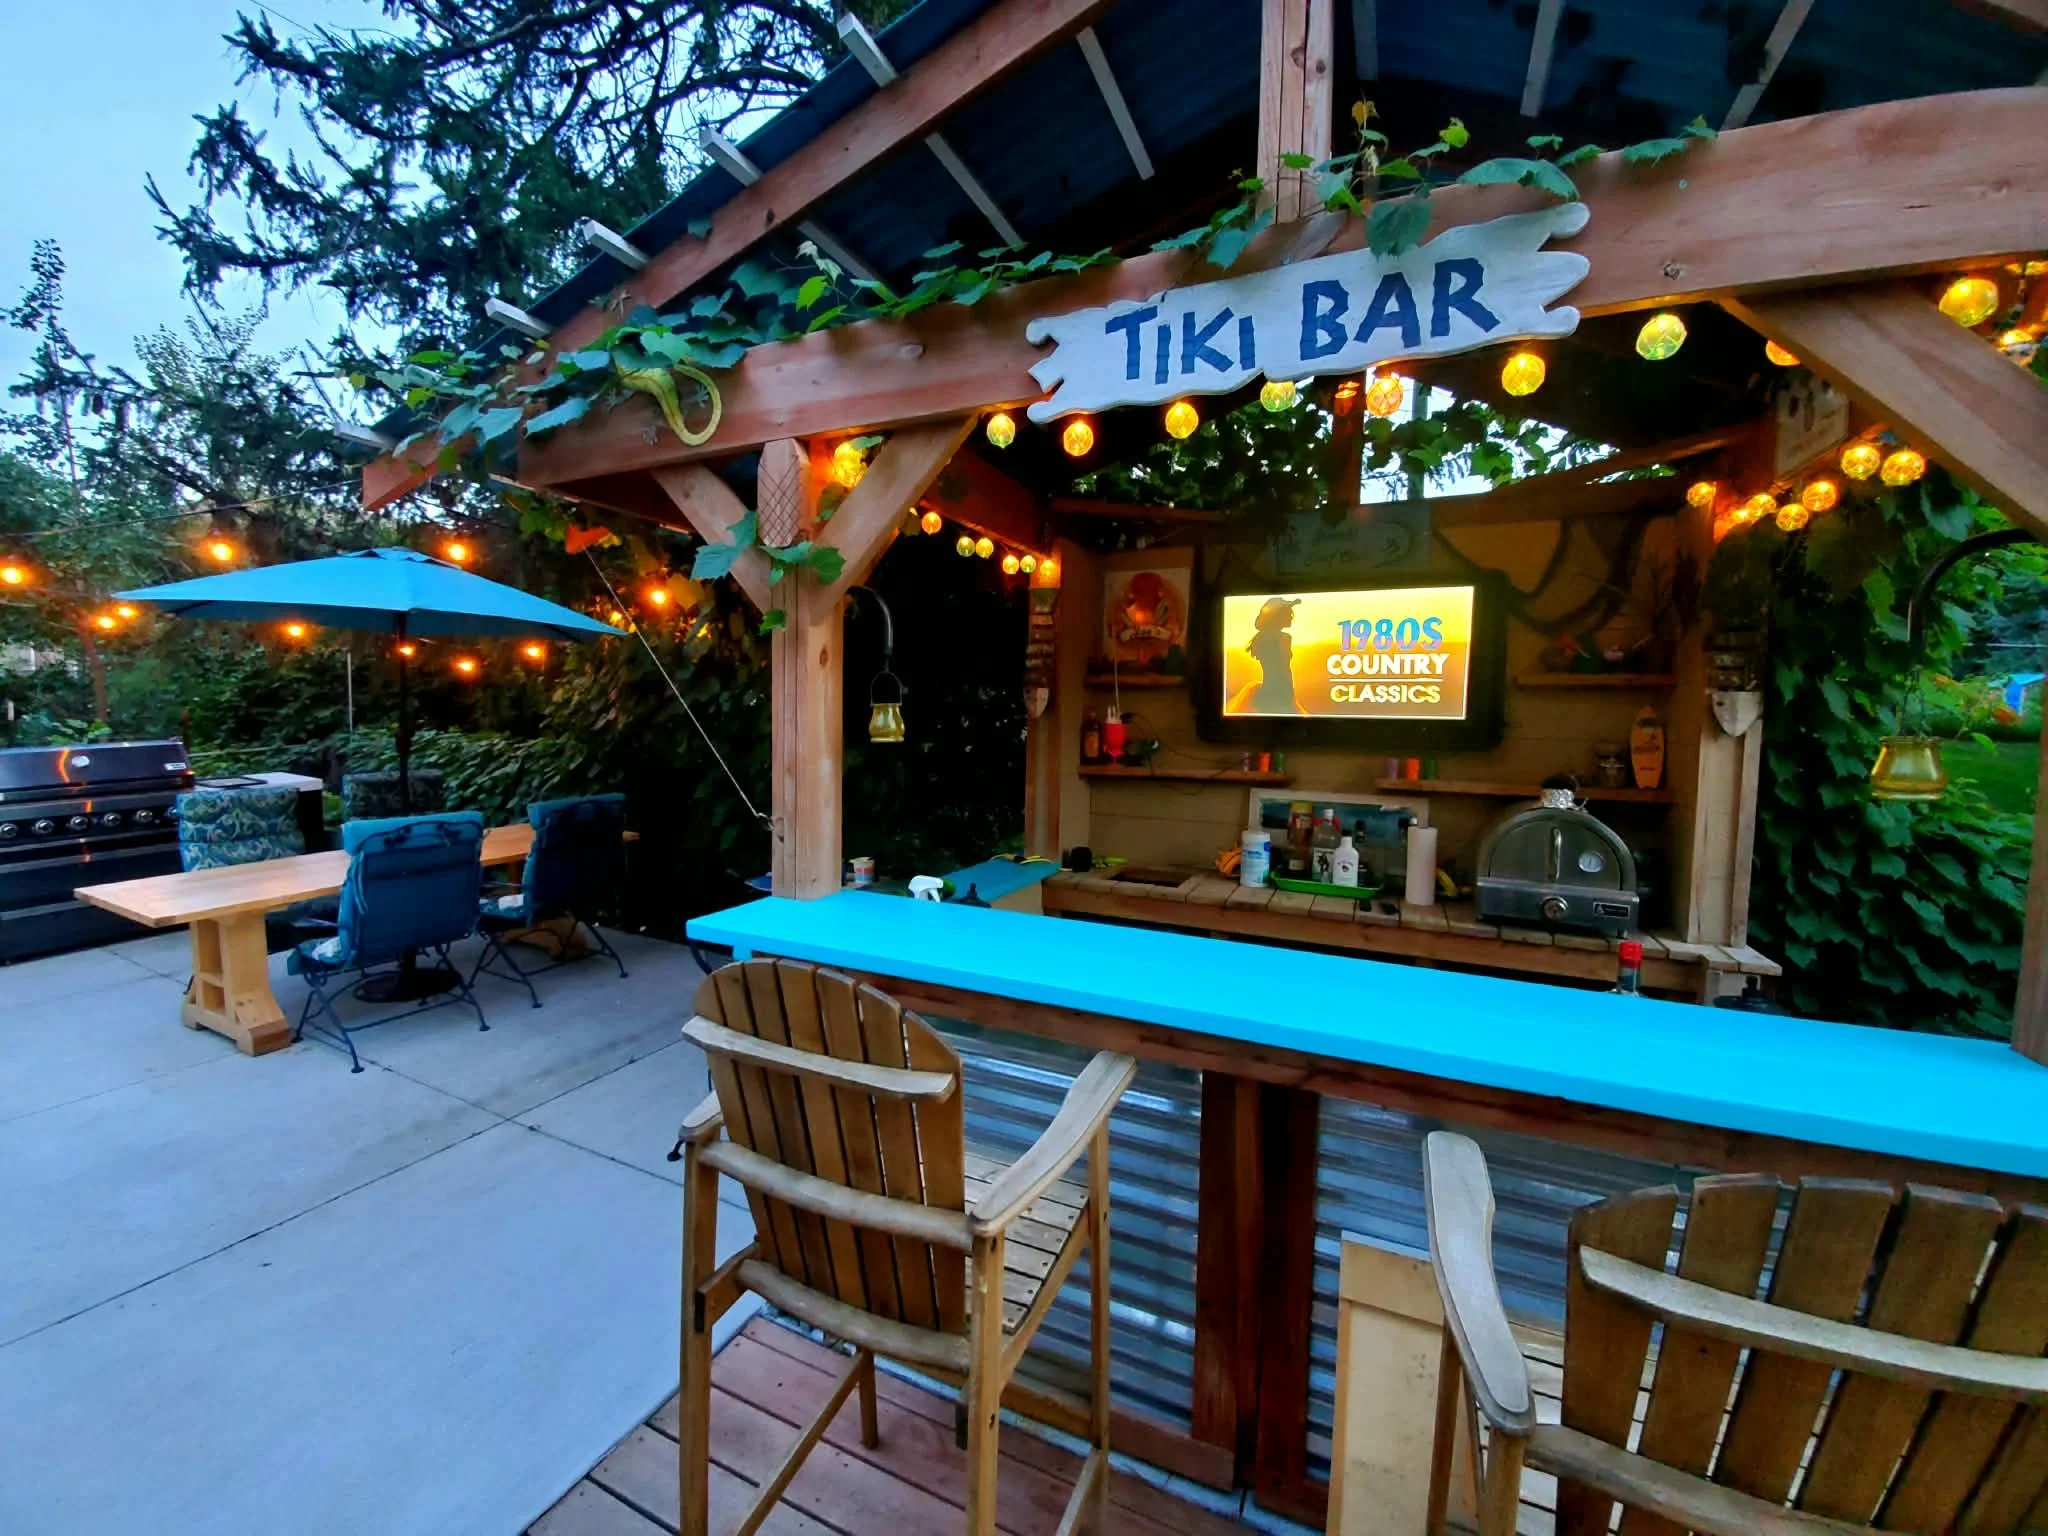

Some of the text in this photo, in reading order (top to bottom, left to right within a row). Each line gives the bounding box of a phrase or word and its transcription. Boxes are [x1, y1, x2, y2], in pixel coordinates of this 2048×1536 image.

[1105, 256, 1501, 384] TIKI BAR
[1337, 616, 1443, 651] 1980S
[1326, 653, 1449, 676] COUNTRY
[1330, 683, 1441, 704] CLASSICS
